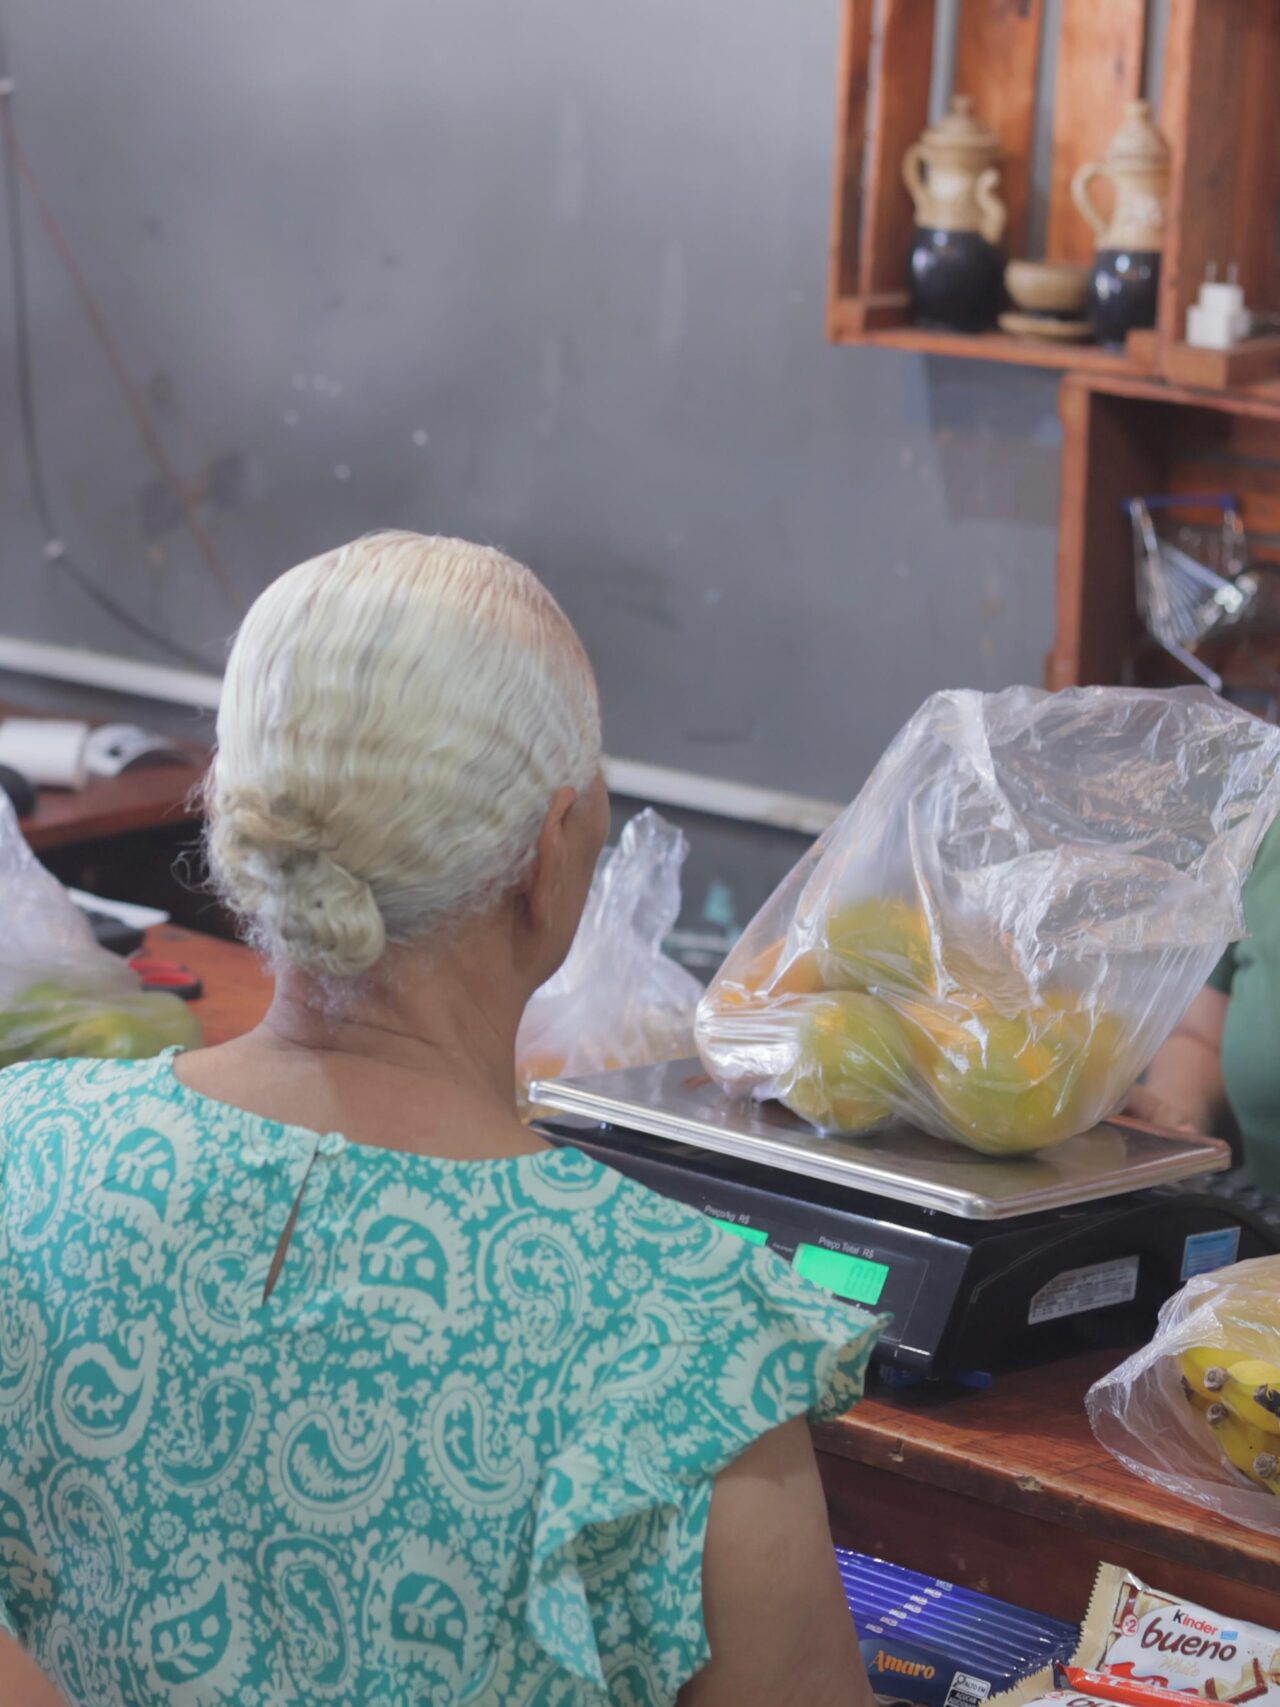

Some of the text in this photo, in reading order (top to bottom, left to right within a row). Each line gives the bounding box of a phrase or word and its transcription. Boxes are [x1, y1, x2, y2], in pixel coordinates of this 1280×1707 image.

[819, 1236, 875, 1259] Preço Total R$
[1141, 1617, 1237, 1661] bueno
[870, 1650, 935, 1679] Amaro
